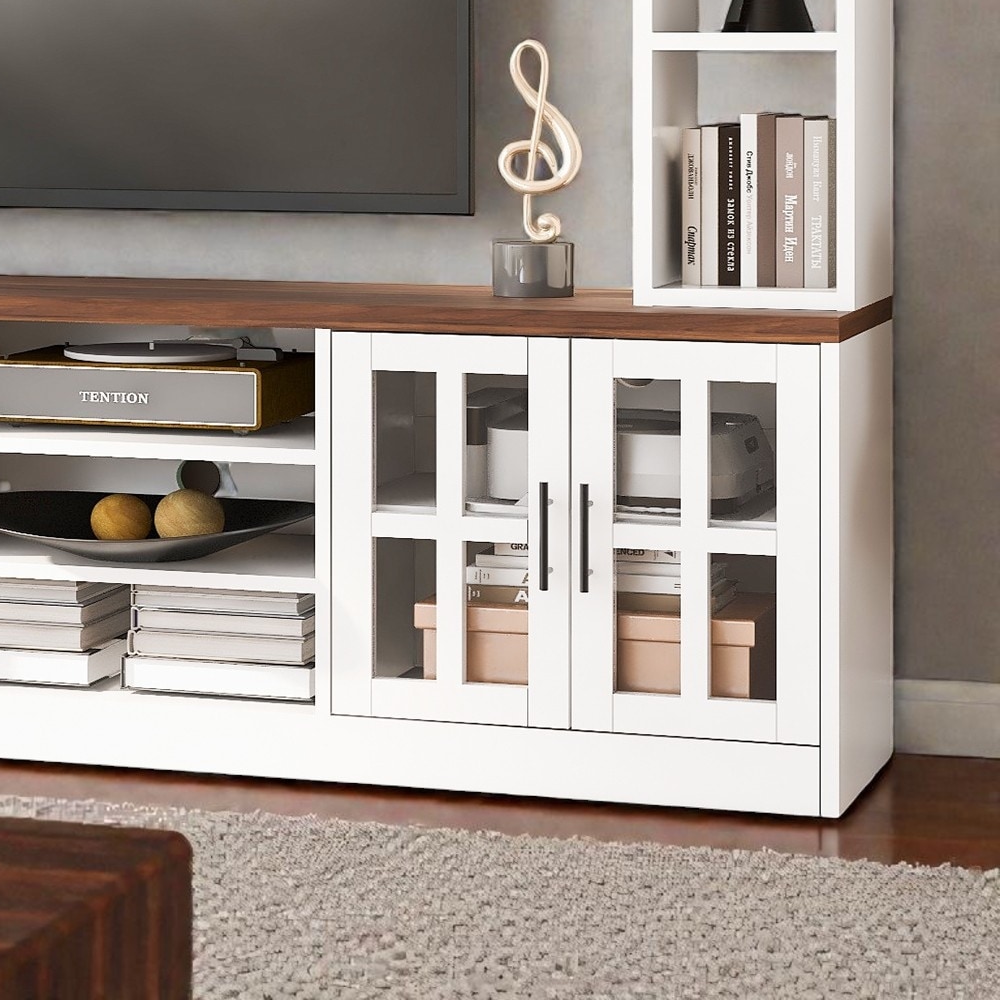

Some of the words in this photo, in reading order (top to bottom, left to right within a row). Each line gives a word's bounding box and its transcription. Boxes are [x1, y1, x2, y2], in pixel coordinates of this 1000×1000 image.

[746, 150, 754, 167] Стив
[745, 168, 754, 194] Джобс
[782, 194, 798, 233] Мартин
[685, 225, 698, 266] Спартак
[784, 237, 798, 263] Иден
[811, 215, 822, 270] ТРАКТАТЫ
[79, 391, 149, 405] TENTION
